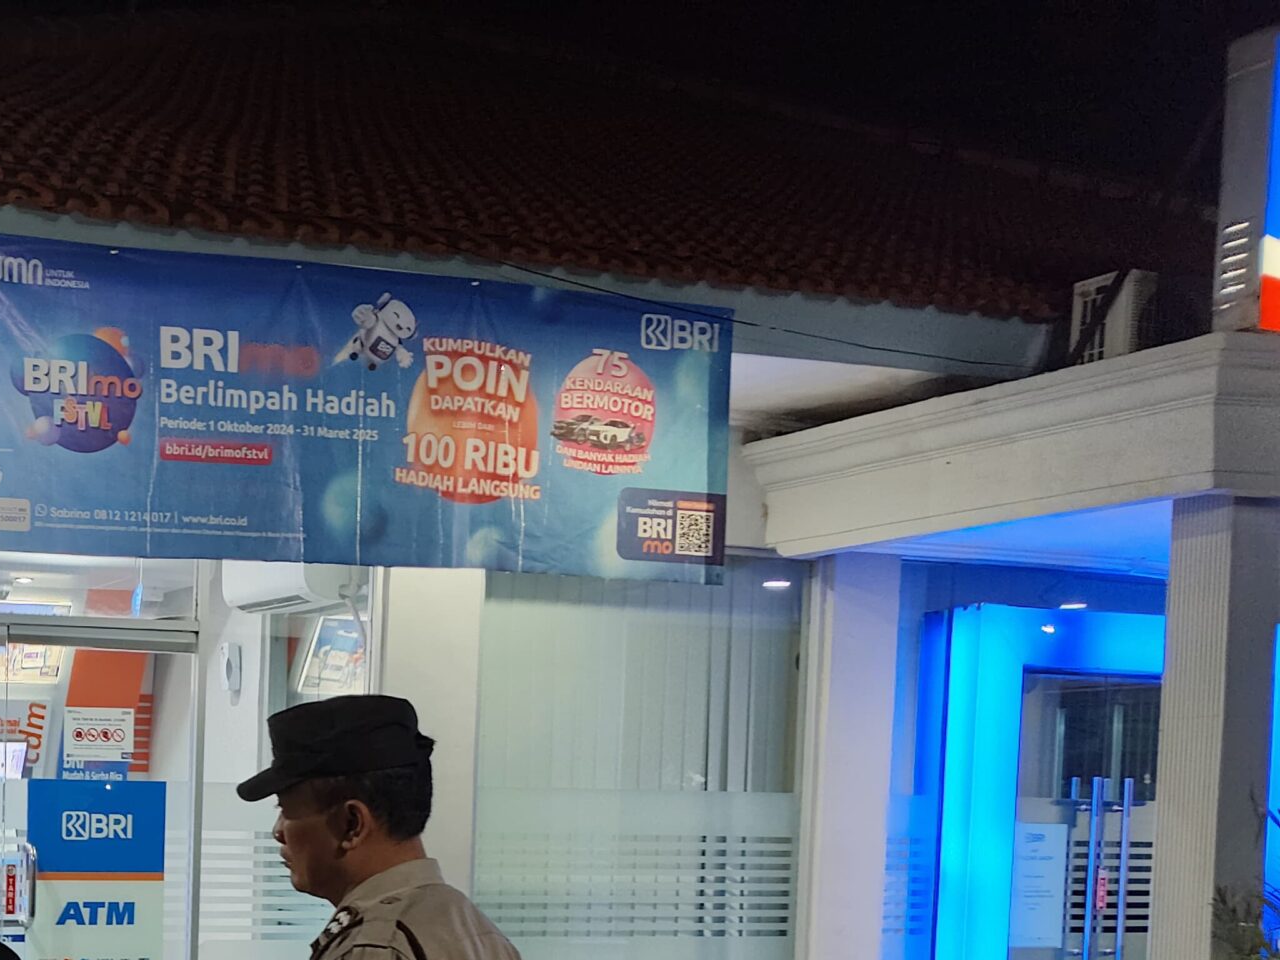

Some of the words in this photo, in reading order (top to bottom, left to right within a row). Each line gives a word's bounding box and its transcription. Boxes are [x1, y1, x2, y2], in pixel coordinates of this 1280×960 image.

[673, 320, 719, 352] BRI
[423, 338, 532, 366] KUMPULKAN
[592, 348, 629, 378] 75
[24, 357, 142, 399] BRImo
[426, 354, 530, 403] POIN
[566, 377, 654, 401] KENDARAAN
[160, 378, 297, 414] Berlimpah
[306, 388, 396, 418] Hadiah
[431, 395, 520, 423] DAPATKAN
[560, 393, 654, 421] BERMOTOR
[53, 397, 112, 430] FSTVL
[160, 416, 206, 430] Periode:
[208, 419, 214, 431] 1
[217, 421, 264, 434] Oktober
[267, 424, 294, 435] 2024
[302, 423, 315, 436] 31
[317, 425, 350, 439] Maret
[353, 428, 379, 441] 2025
[165, 442, 269, 460] bbri.id/brimofstvl
[403, 433, 456, 468] 100
[464, 437, 540, 479] RIBU
[577, 449, 614, 462] BANYAK
[395, 468, 454, 492] HADIAH
[457, 477, 541, 499] LANGSUNG
[50, 507, 90, 520] Sabrina
[637, 517, 672, 539] BRI
[642, 540, 673, 554] mo
[19, 702, 46, 765] cdm
[91, 814, 133, 839] BRI
[56, 902, 136, 926] ATM
